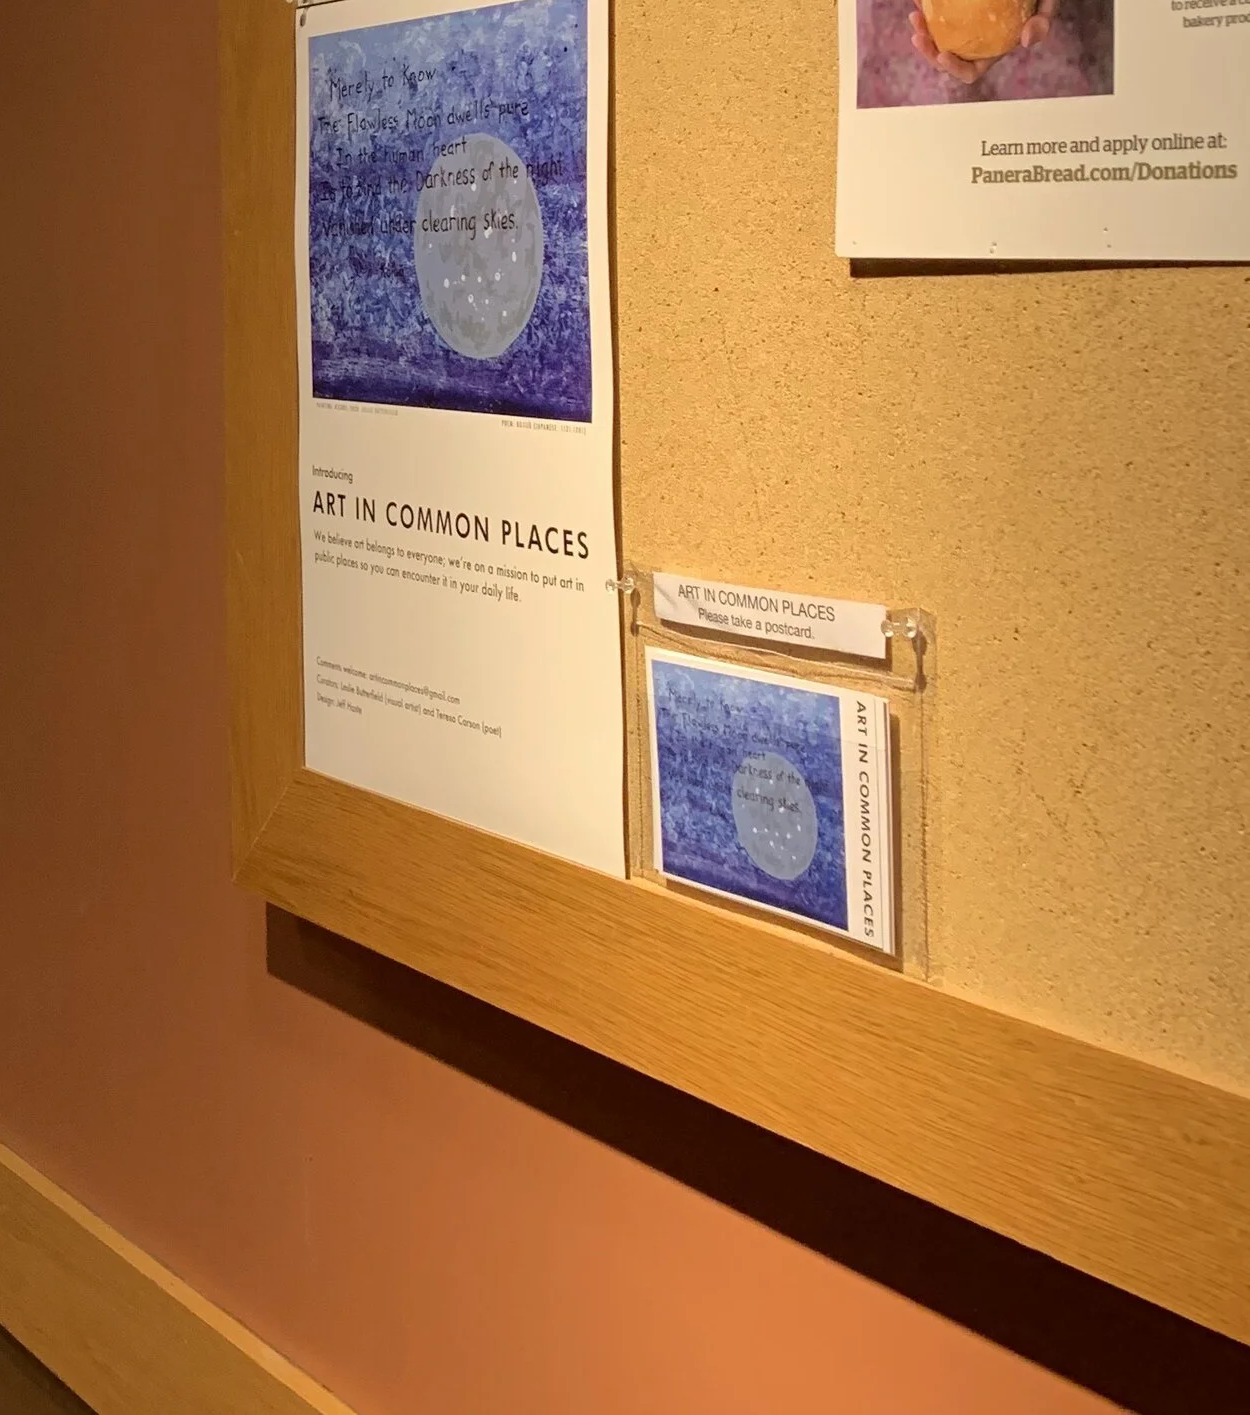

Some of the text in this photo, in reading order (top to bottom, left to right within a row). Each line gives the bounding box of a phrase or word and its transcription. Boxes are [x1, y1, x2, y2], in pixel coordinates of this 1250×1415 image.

[1171, 0, 1184, 11] to
[1182, 15, 1224, 28] bakery
[329, 63, 437, 102] Merely to Know
[405, 108, 441, 129] Moon
[447, 99, 490, 124] dwells
[981, 132, 1227, 156] Learn more and apply online at:
[416, 167, 476, 192] Darkness
[482, 161, 494, 181] of
[499, 156, 519, 179] the
[971, 161, 1238, 184] PaneraBread.com/Donations
[422, 209, 476, 240] clearing
[484, 209, 518, 230] skies.
[312, 464, 353, 484] Introducing
[313, 490, 589, 560] ART IN COMMON PLACES
[314, 529, 326, 543] We
[327, 531, 352, 548] believe
[354, 540, 364, 549] art
[366, 538, 395, 559] belongs
[397, 547, 405, 557] to
[406, 550, 445, 567] everyone;
[474, 562, 485, 573] on
[487, 565, 493, 575] a
[496, 564, 528, 581] mission
[530, 570, 540, 583] to
[542, 575, 557, 588] put
[559, 577, 573, 589] art
[575, 577, 584, 592] in
[314, 550, 522, 602] public places so you can encounter it in your daily life.
[678, 584, 835, 621] ART IN COMMON PLACES
[698, 609, 815, 639] Please take a postcard.
[422, 707, 435, 717] and
[857, 701, 874, 937] ART IN COMMON PLACES
